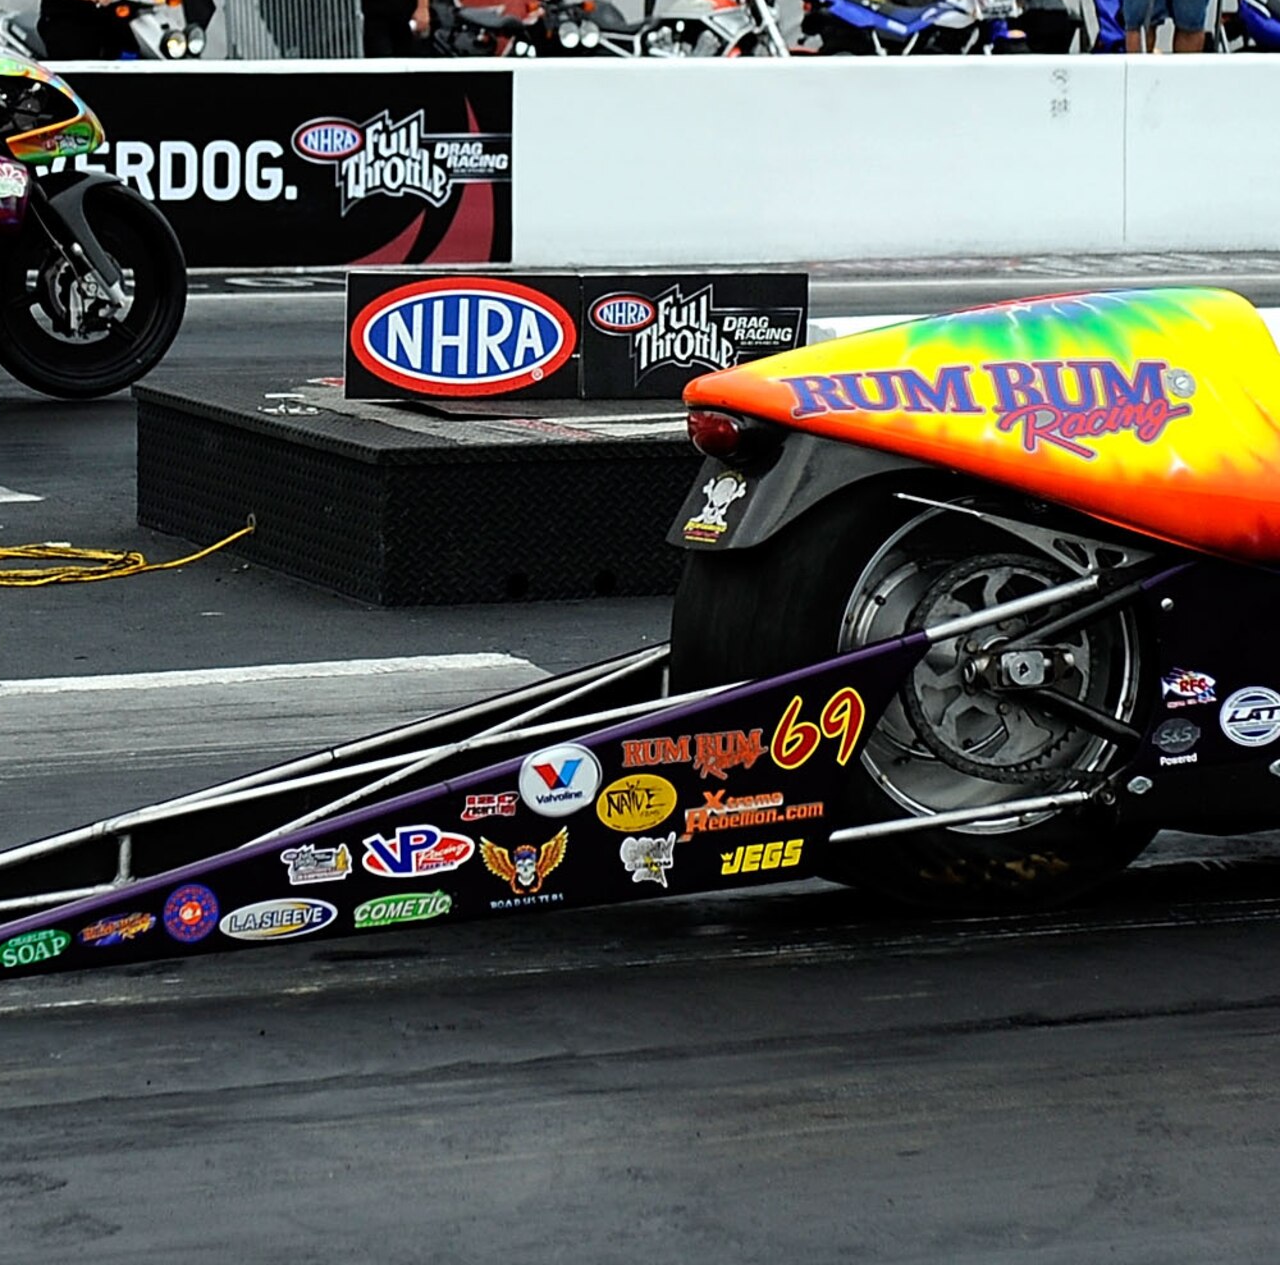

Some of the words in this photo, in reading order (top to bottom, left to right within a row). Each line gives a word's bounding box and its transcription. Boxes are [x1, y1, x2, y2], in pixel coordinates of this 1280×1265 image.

[306, 127, 357, 154] NHRA
[366, 120, 422, 162] Full
[434, 142, 483, 160] DRAG
[447, 153, 509, 171] RACING
[598, 301, 650, 326] NHRA
[658, 294, 709, 336] Full
[723, 316, 770, 333] DRAG
[735, 327, 792, 342] RACING
[387, 298, 545, 375] NHRA
[785, 365, 984, 418] RUM
[982, 360, 1169, 415] BUM
[997, 397, 1192, 460] Racing
[622, 736, 691, 767] RUM
[693, 728, 764, 761] BUM
[770, 687, 865, 769] 69
[1159, 752, 1198, 767] Powered
[536, 789, 583, 805] Valvoline
[703, 789, 784, 811] Xtreme
[680, 801, 824, 842] Rebellion.com
[368, 828, 441, 874] VP
[721, 839, 805, 876] JEGS
[354, 892, 451, 923] COMETIC
[3, 936, 67, 968] SOAP
